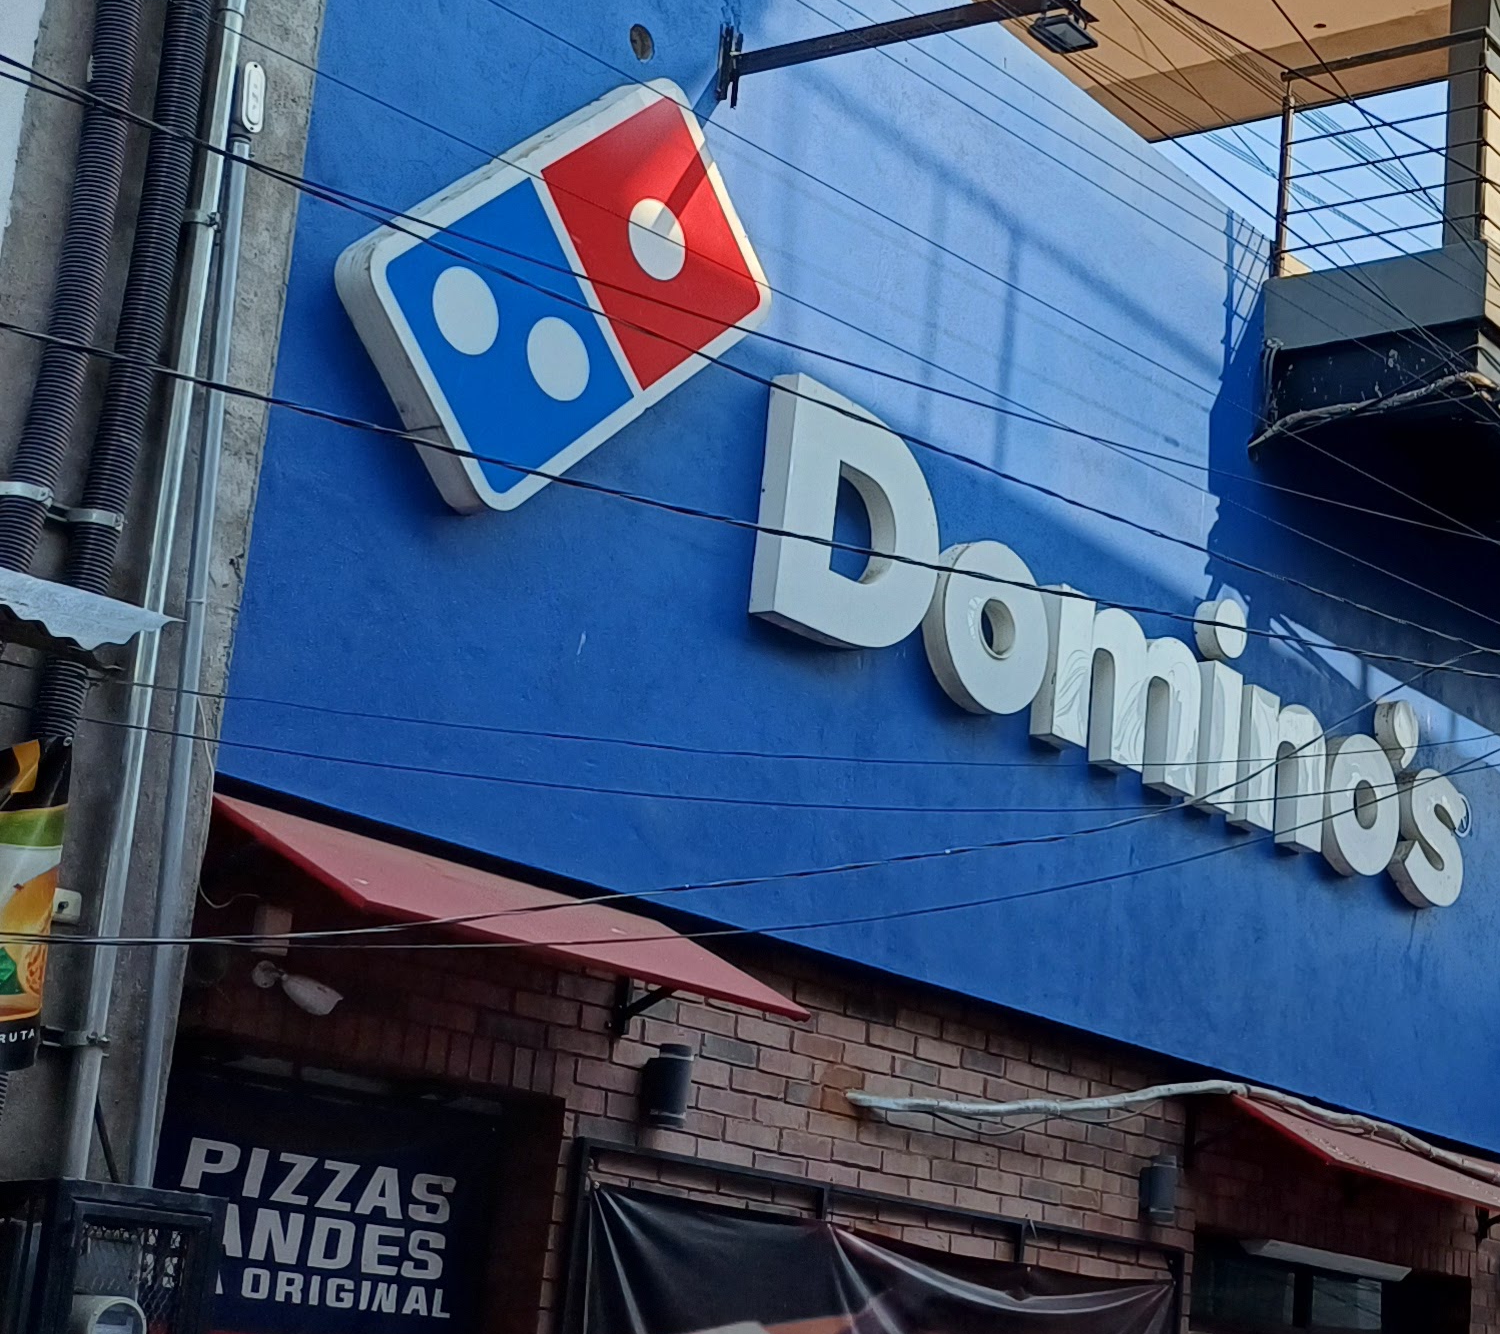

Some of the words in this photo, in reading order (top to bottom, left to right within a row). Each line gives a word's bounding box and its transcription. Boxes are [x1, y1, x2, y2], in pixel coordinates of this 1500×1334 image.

[749, 372, 1466, 908] Domino's
[180, 1137, 457, 1224] PIZZAS
[241, 1267, 451, 1318] ORIGINAL
